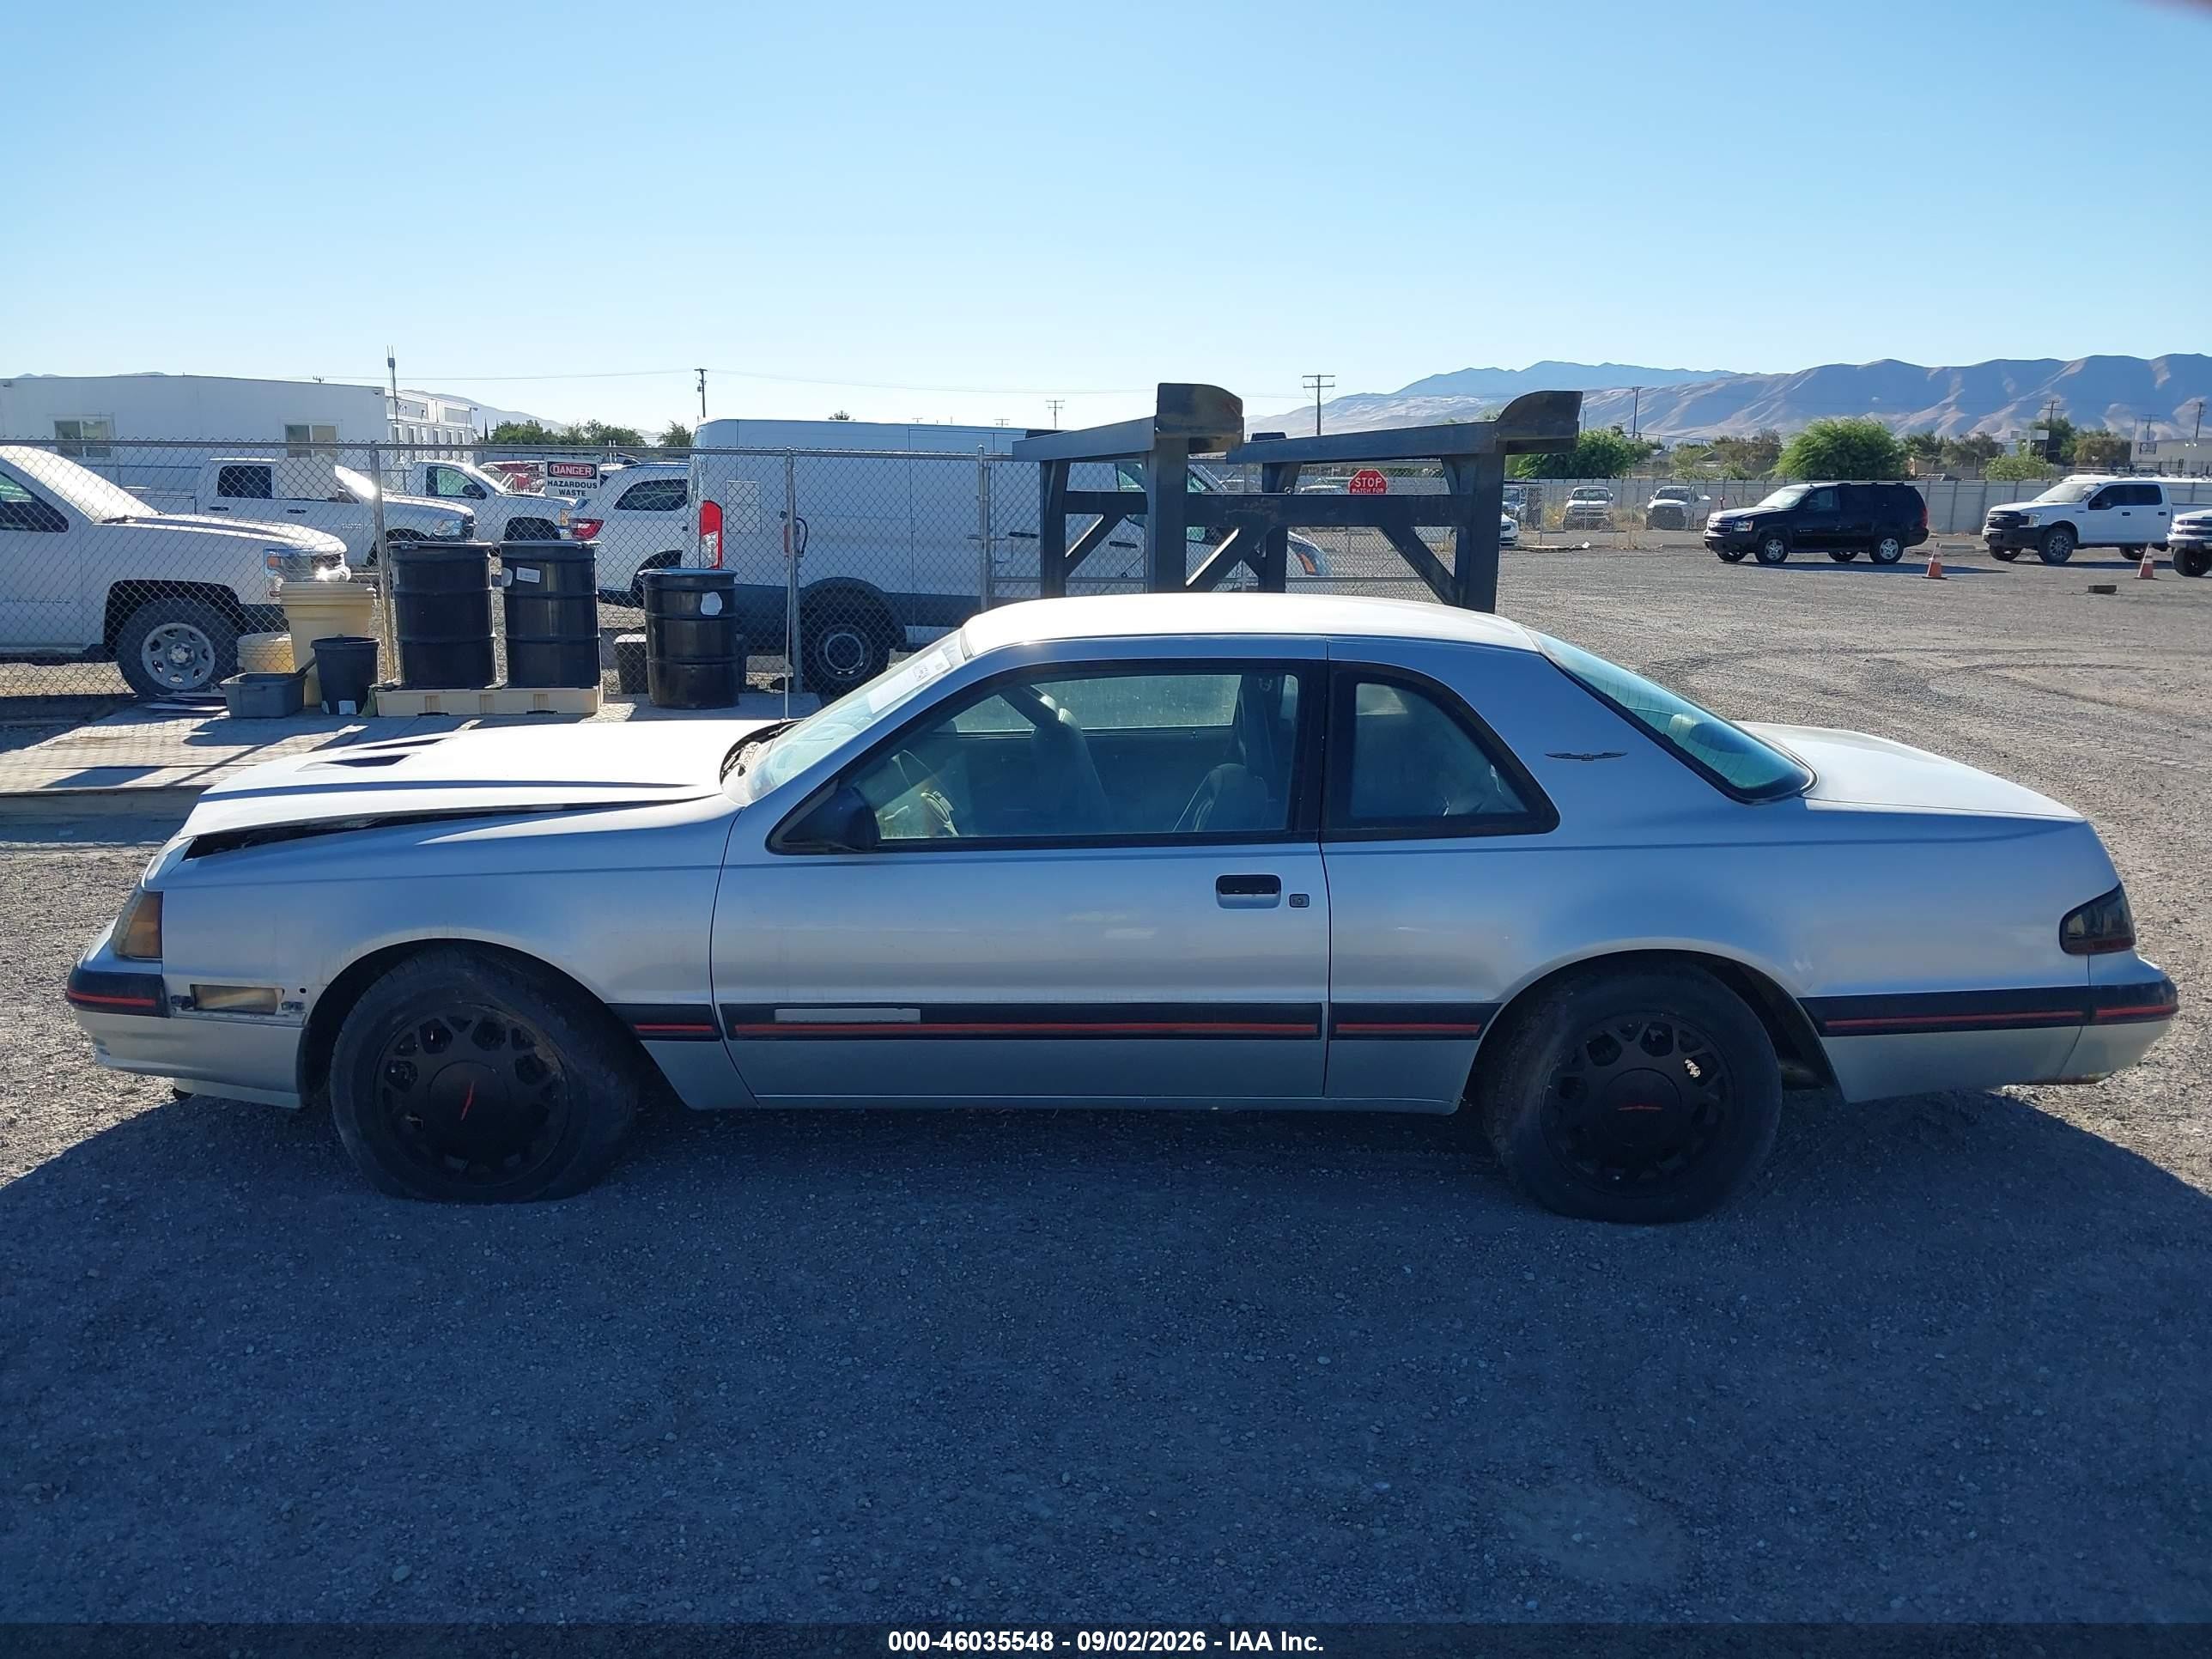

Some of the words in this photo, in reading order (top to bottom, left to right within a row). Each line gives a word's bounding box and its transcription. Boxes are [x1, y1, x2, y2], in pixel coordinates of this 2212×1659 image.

[552, 466, 592, 476] DANGER
[548, 480, 598, 489] HAZARDOUS
[1354, 477, 1382, 487] STOP
